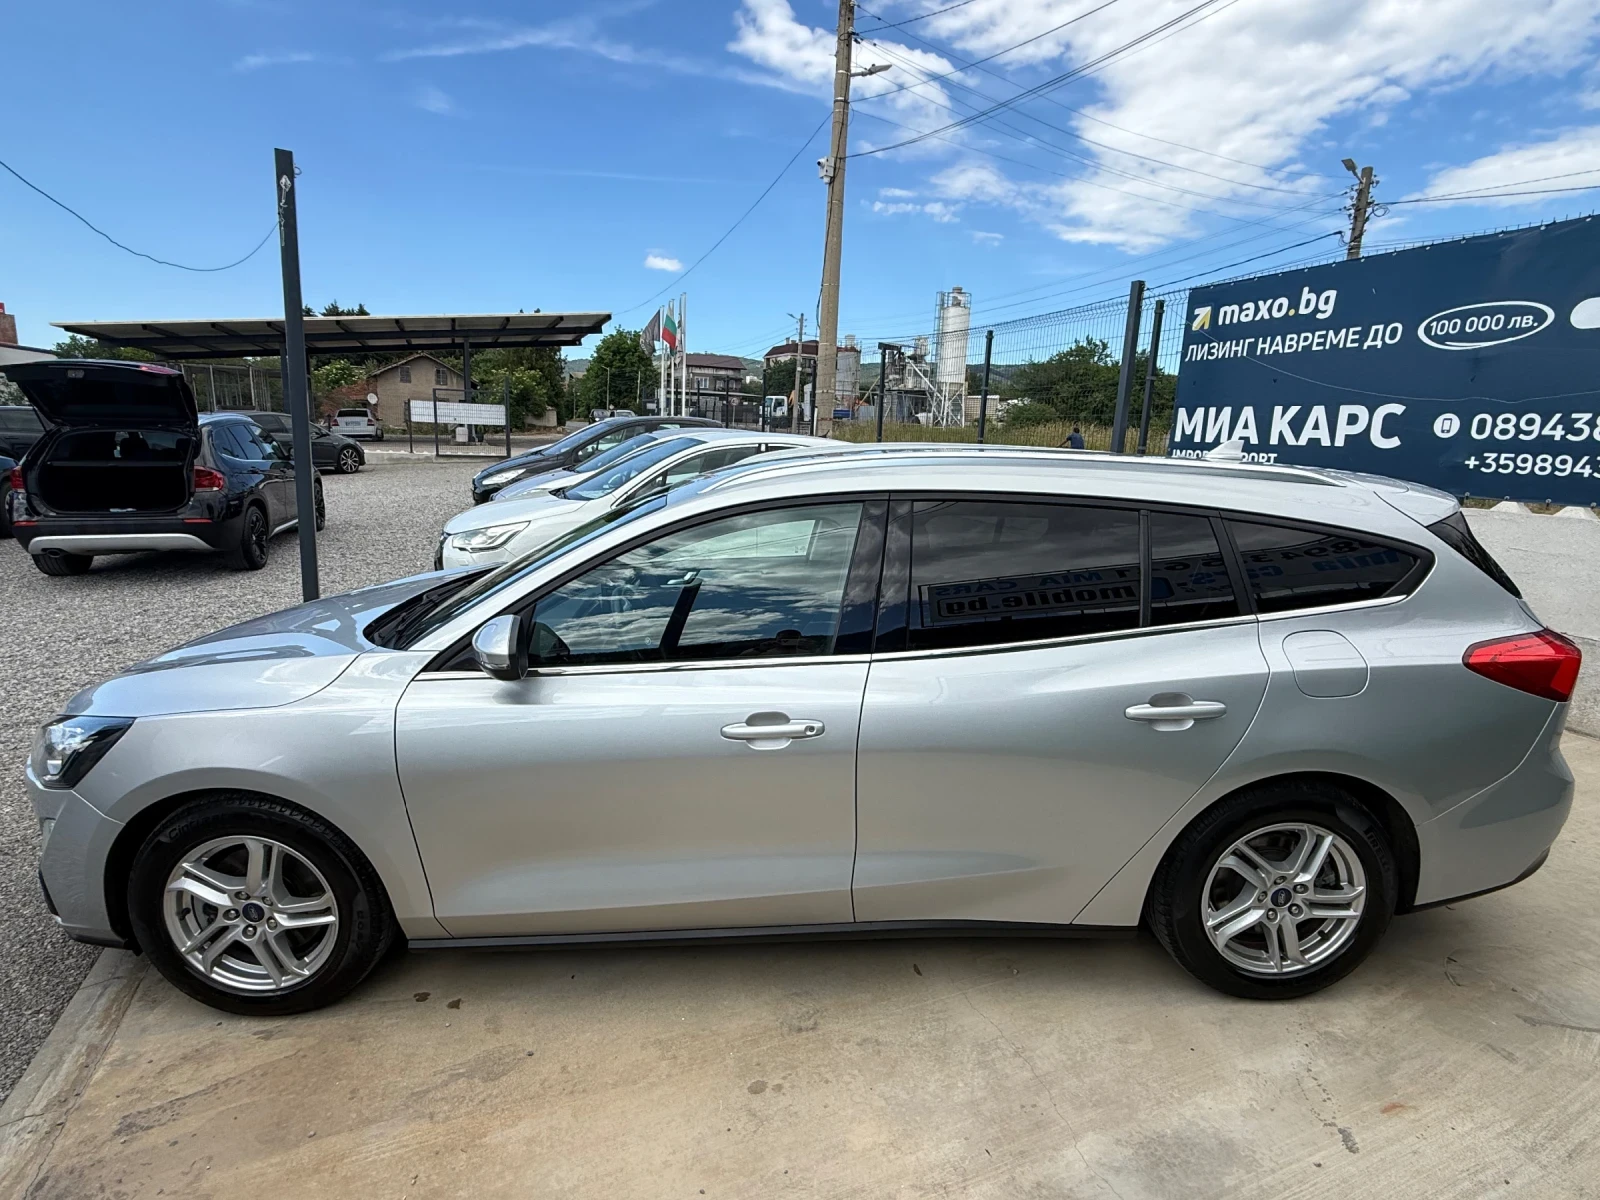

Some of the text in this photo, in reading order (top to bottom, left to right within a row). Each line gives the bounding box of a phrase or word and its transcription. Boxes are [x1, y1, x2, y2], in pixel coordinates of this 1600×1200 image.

[1218, 286, 1337, 325] maxo.bg
[1185, 314, 1539, 362] ЛИЗИНГ НАВРЕМЕ ДО 100 000 лв.
[1174, 403, 1407, 449] МИА КАРС
